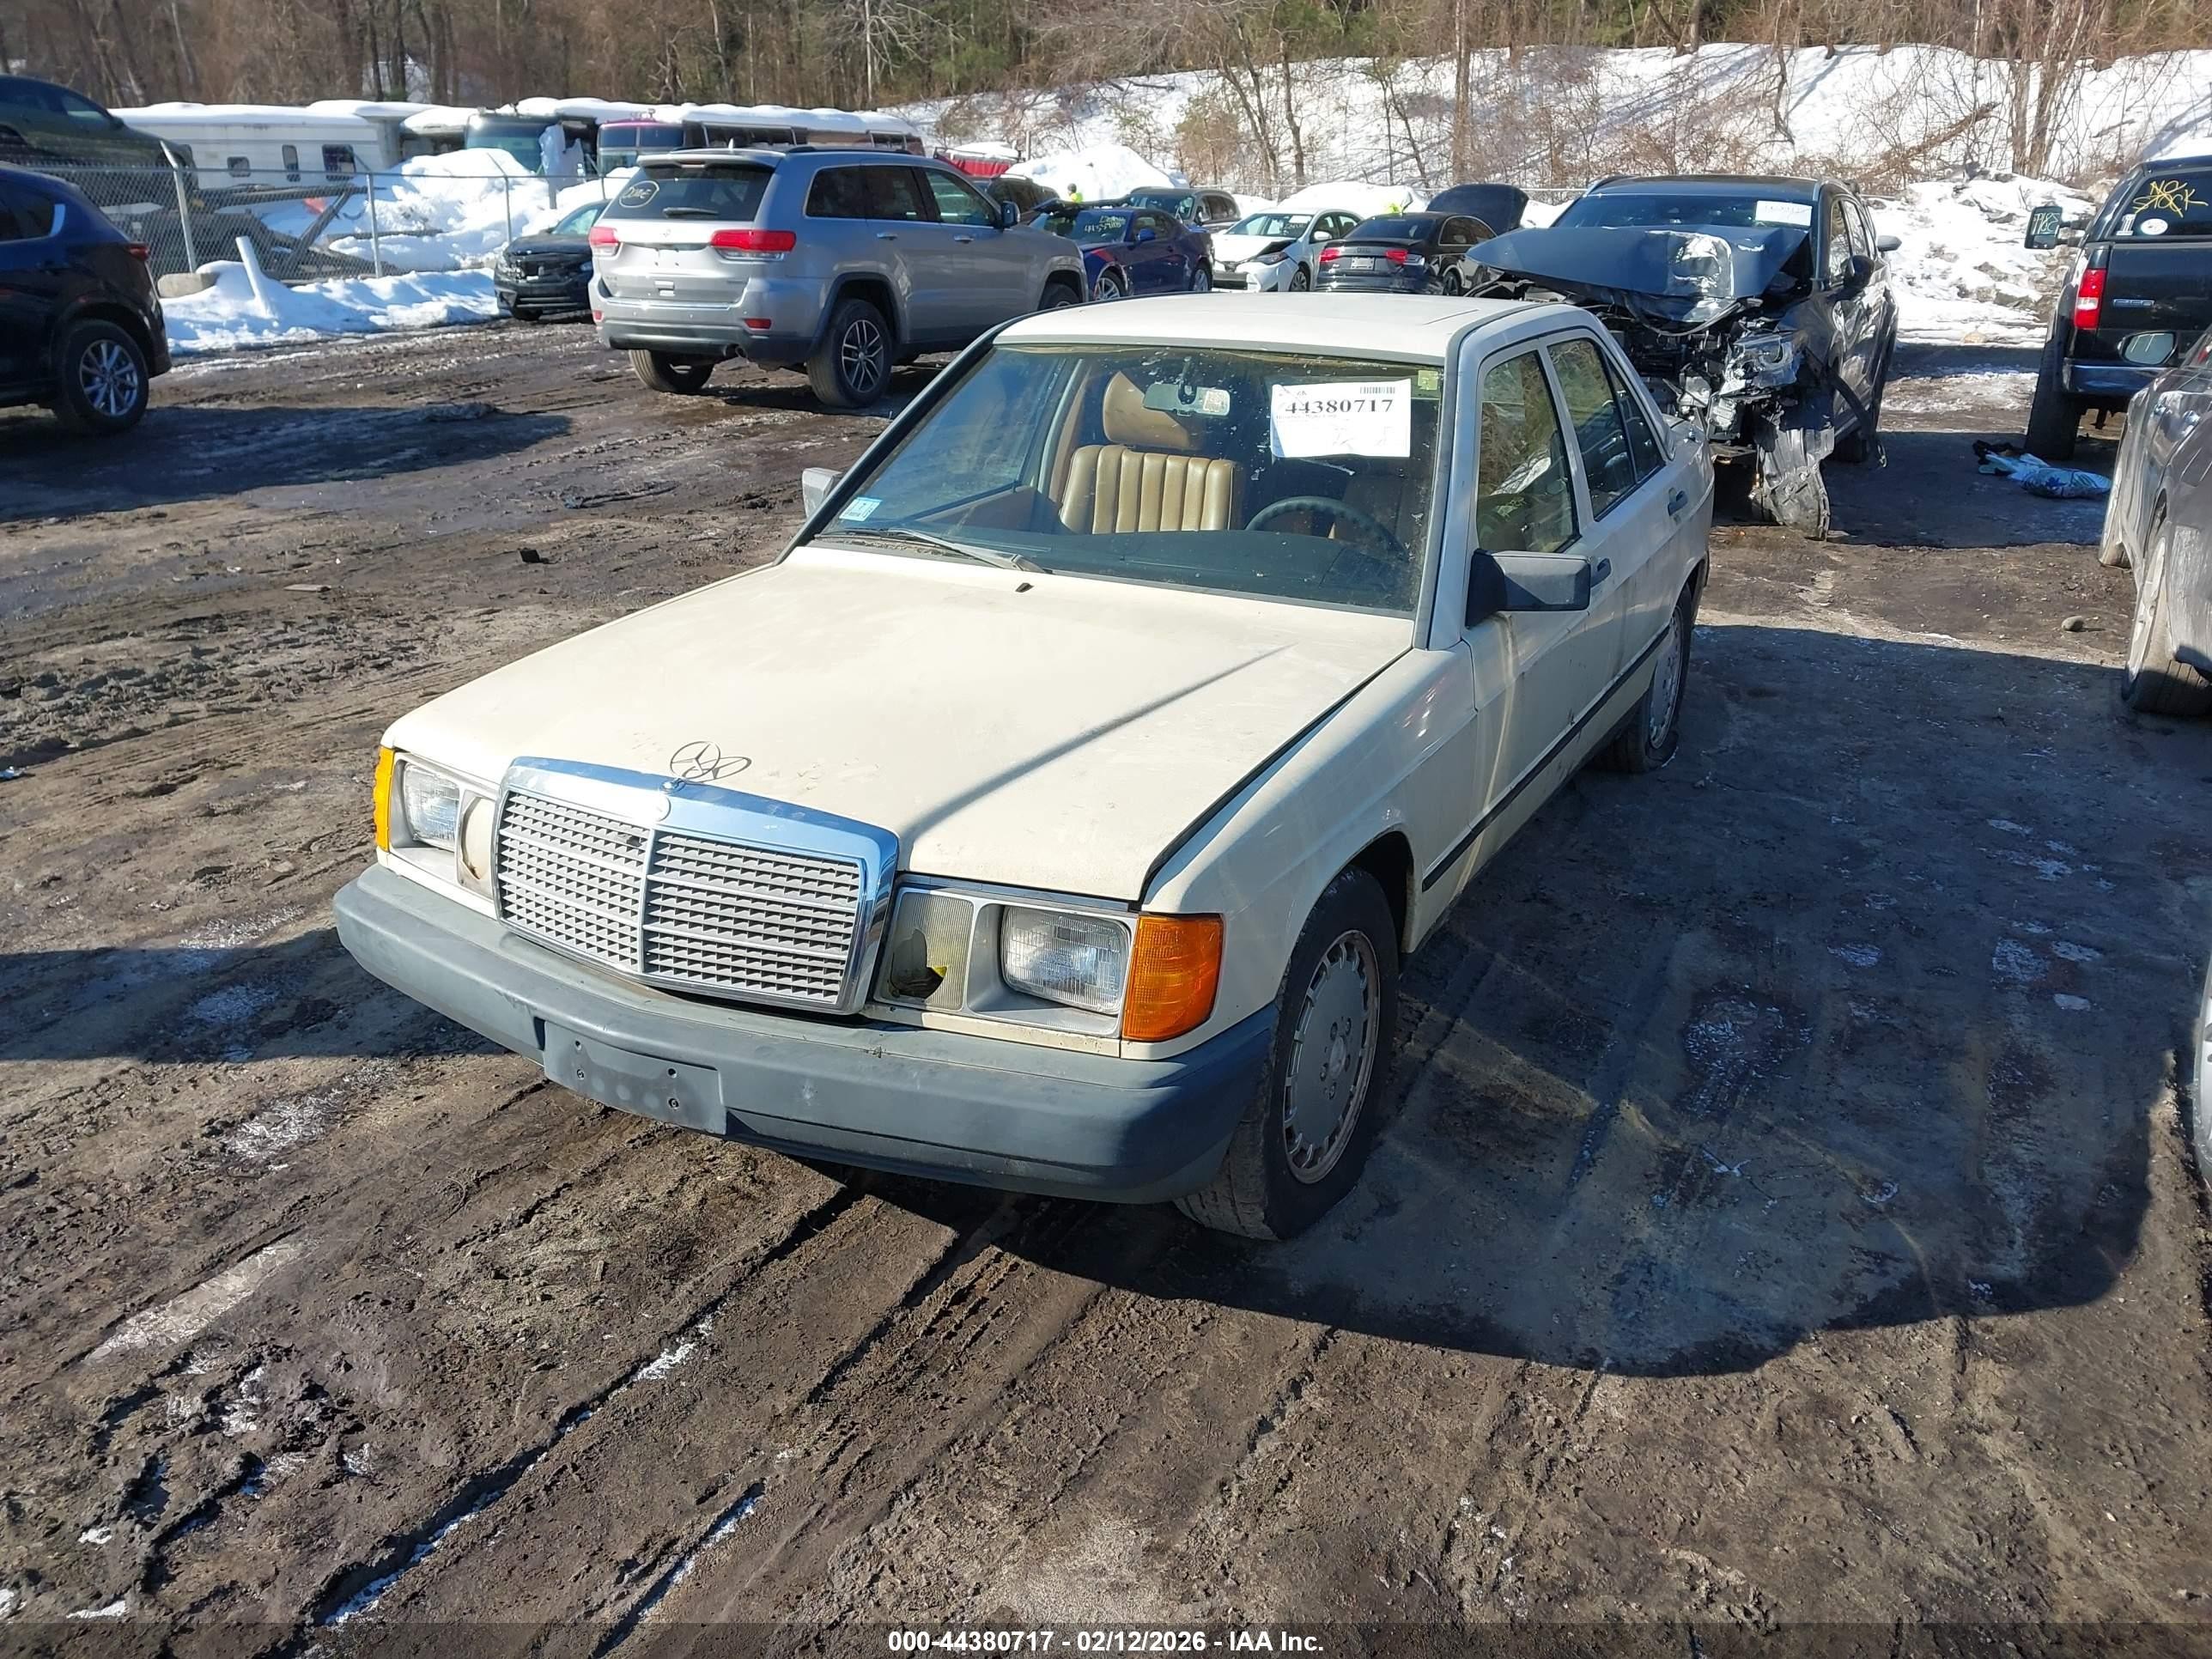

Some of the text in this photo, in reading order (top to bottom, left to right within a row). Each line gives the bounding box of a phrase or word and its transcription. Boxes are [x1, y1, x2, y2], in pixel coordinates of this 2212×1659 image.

[2149, 179, 2188, 196] NO
[2132, 188, 2209, 213] STOCK
[1285, 398, 1394, 415] 44380717
